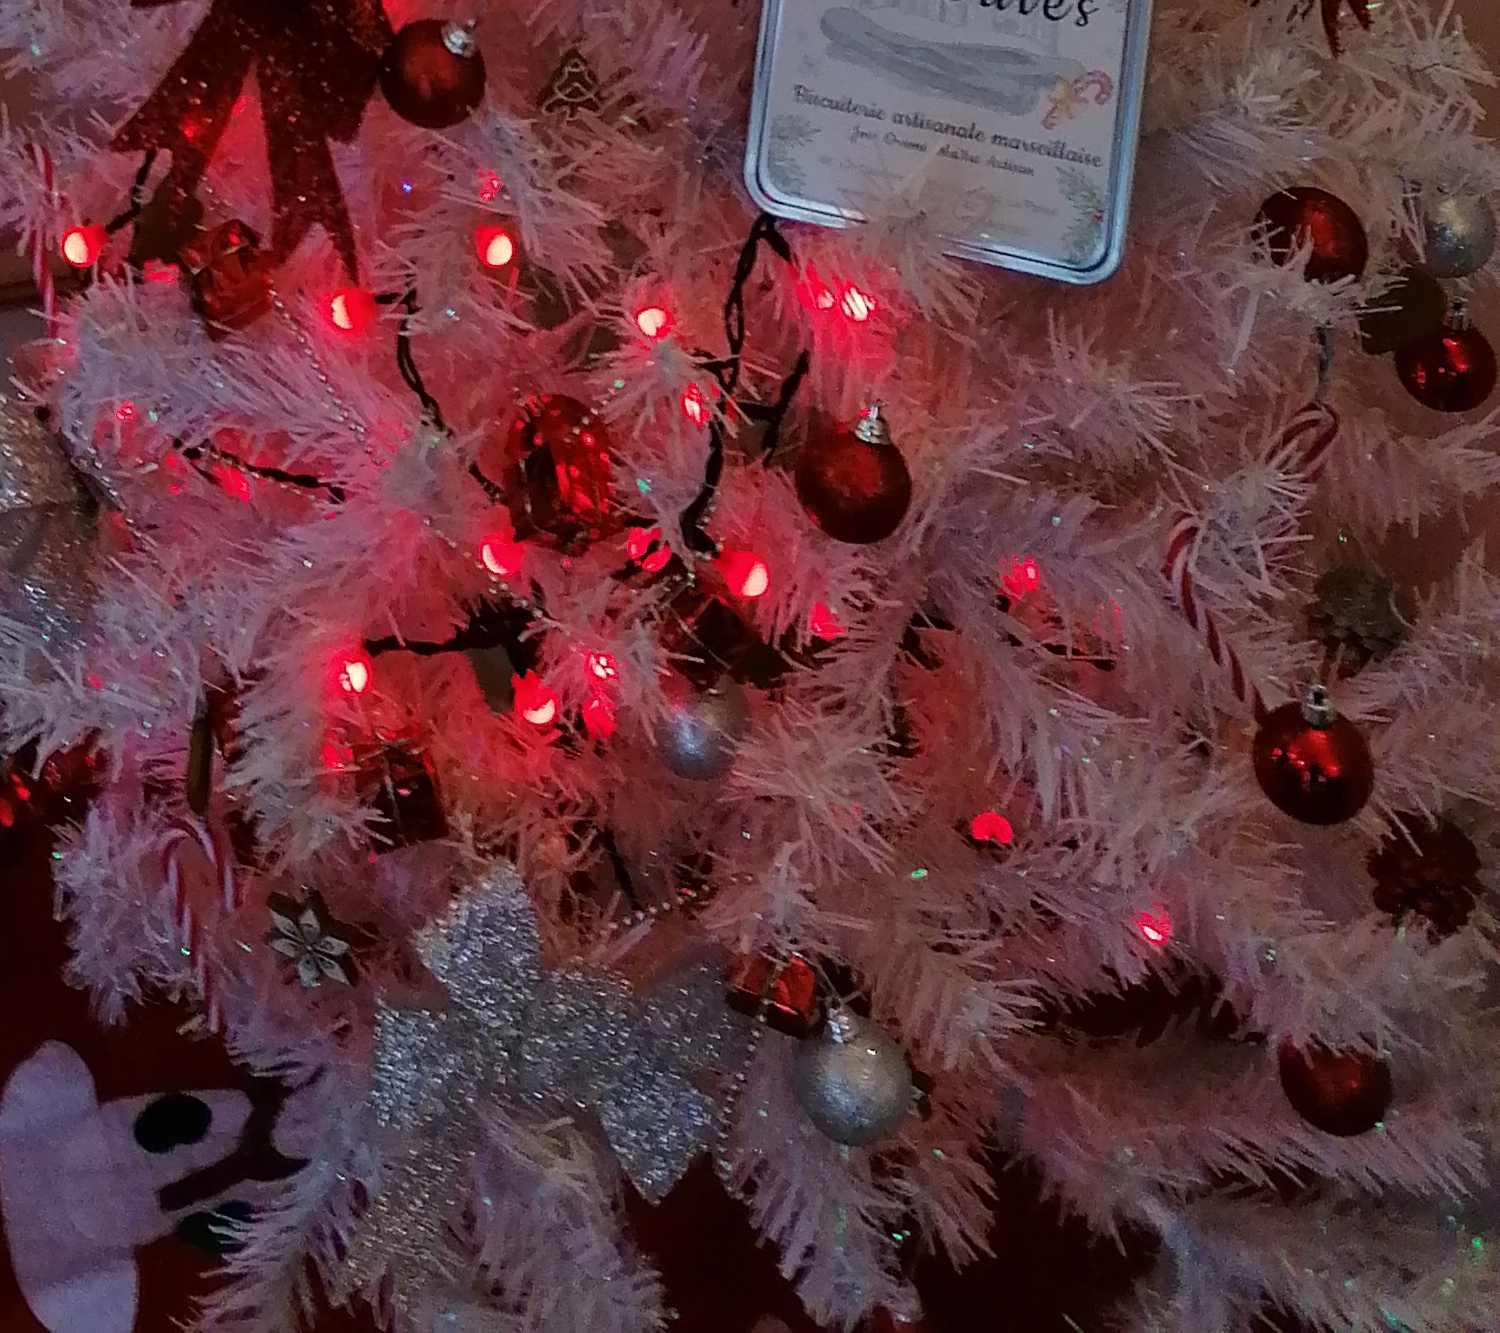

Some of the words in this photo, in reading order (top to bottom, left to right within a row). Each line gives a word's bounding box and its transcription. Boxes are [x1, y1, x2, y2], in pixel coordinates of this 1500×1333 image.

[793, 83, 885, 121] Biscuiterie
[890, 111, 986, 143] artisanale
[990, 131, 1104, 168] marseillaise
